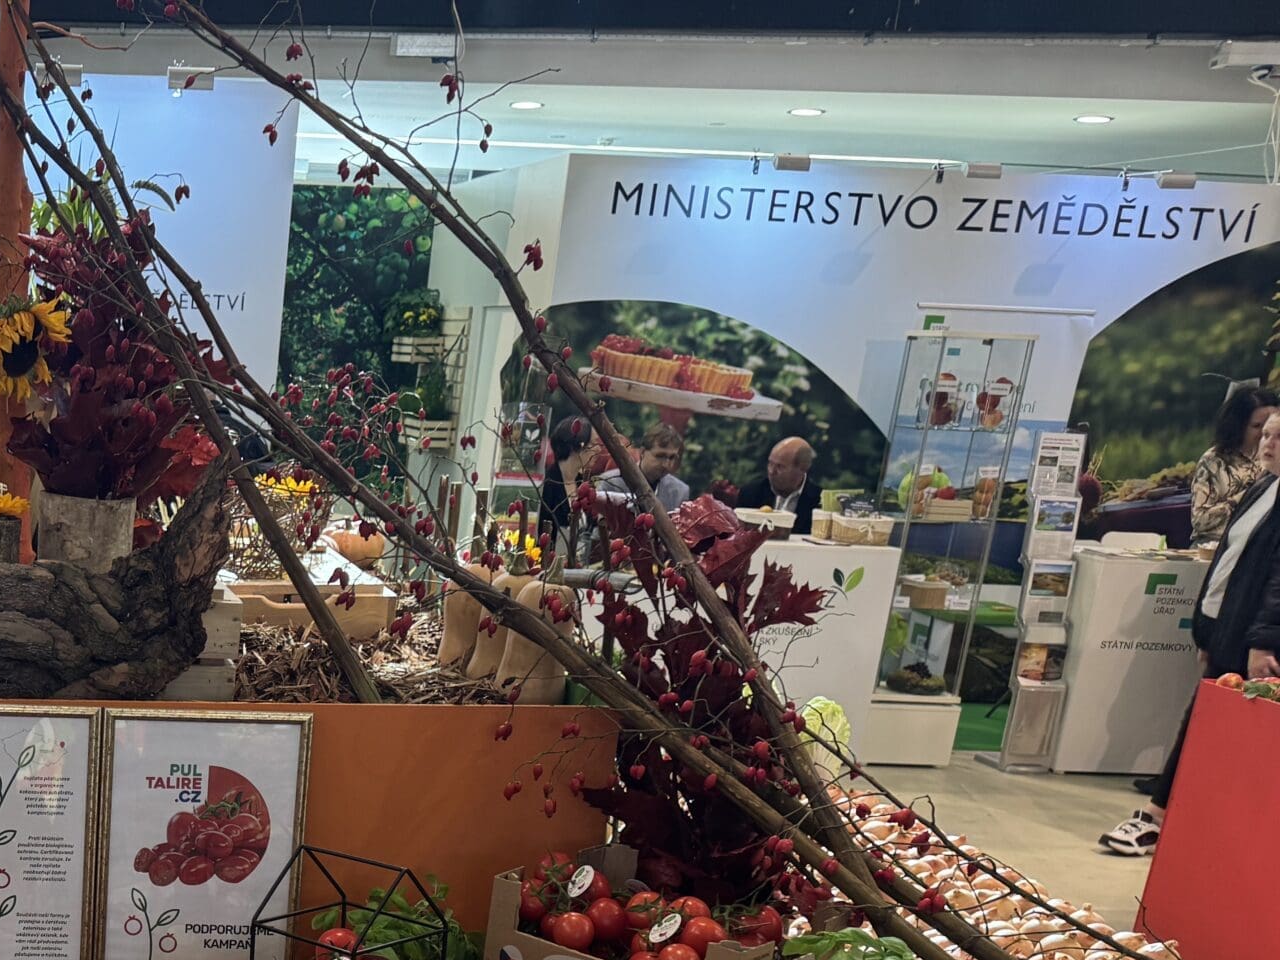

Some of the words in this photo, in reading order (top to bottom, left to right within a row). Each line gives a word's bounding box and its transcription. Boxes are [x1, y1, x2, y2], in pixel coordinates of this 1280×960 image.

[611, 180, 939, 230] MINISTERSTVO
[956, 194, 1263, 243] ZEMĚDĚLSTVÍ
[170, 763, 202, 777] PUL
[146, 777, 202, 790] TALIRE
[174, 790, 201, 803] .CZ
[184, 923, 275, 937] PODPORUJME
